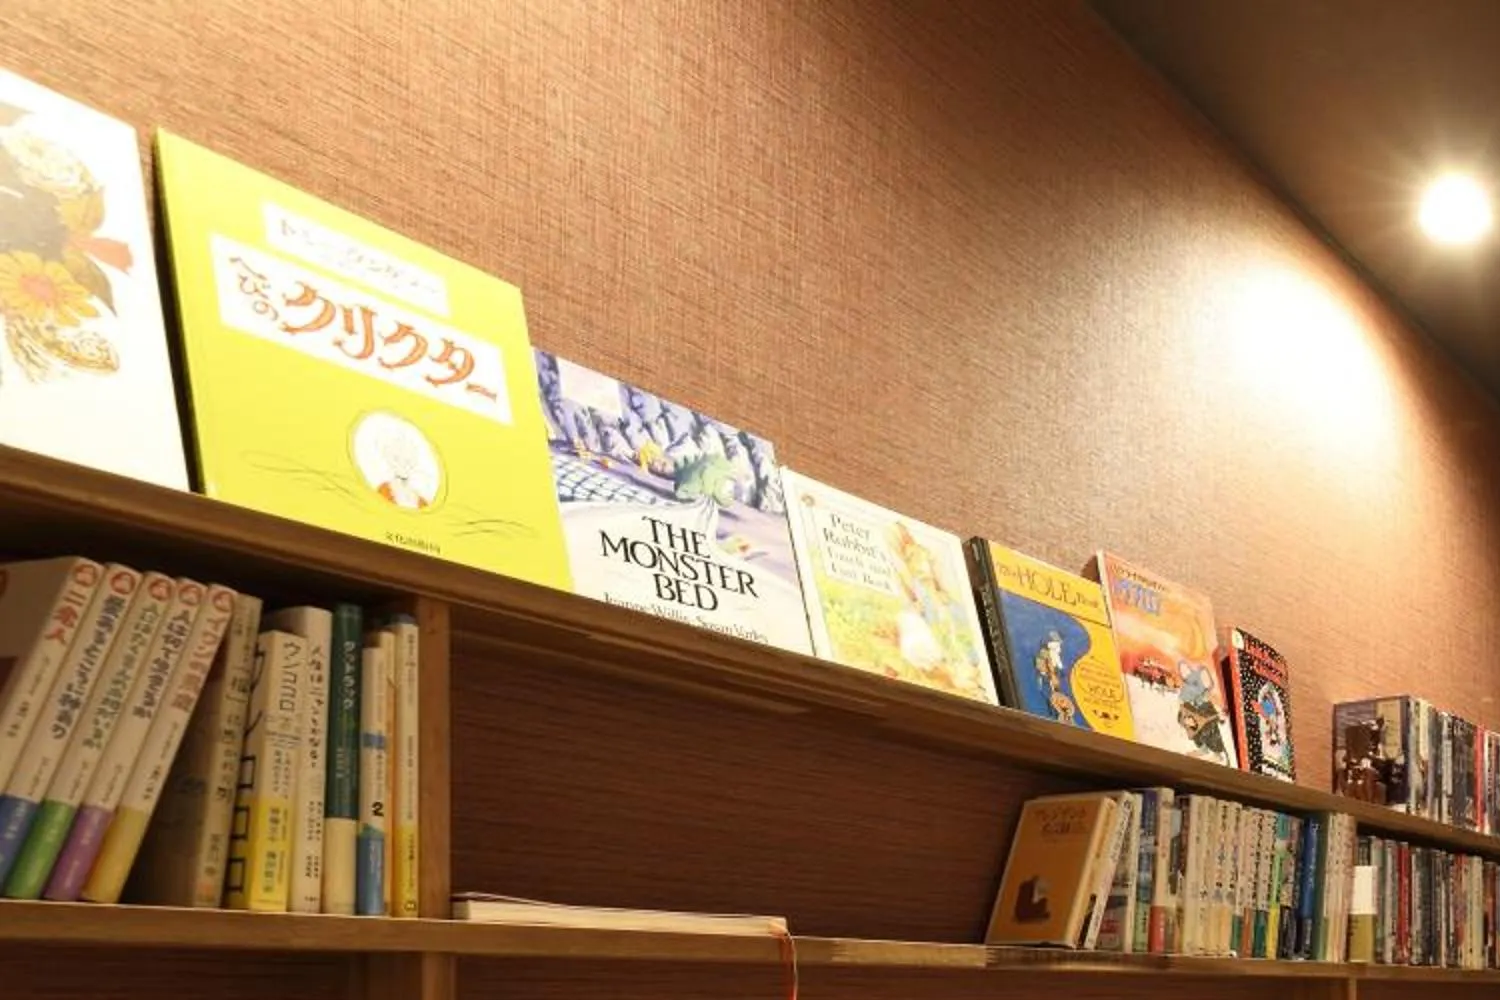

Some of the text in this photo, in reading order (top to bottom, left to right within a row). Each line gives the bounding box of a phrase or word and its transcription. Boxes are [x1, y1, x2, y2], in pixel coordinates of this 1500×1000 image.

[641, 515, 711, 559] THE
[830, 513, 870, 541] Peter
[598, 529, 760, 599] MONSTER
[652, 573, 719, 611] BED
[371, 801, 384, 818] 2
